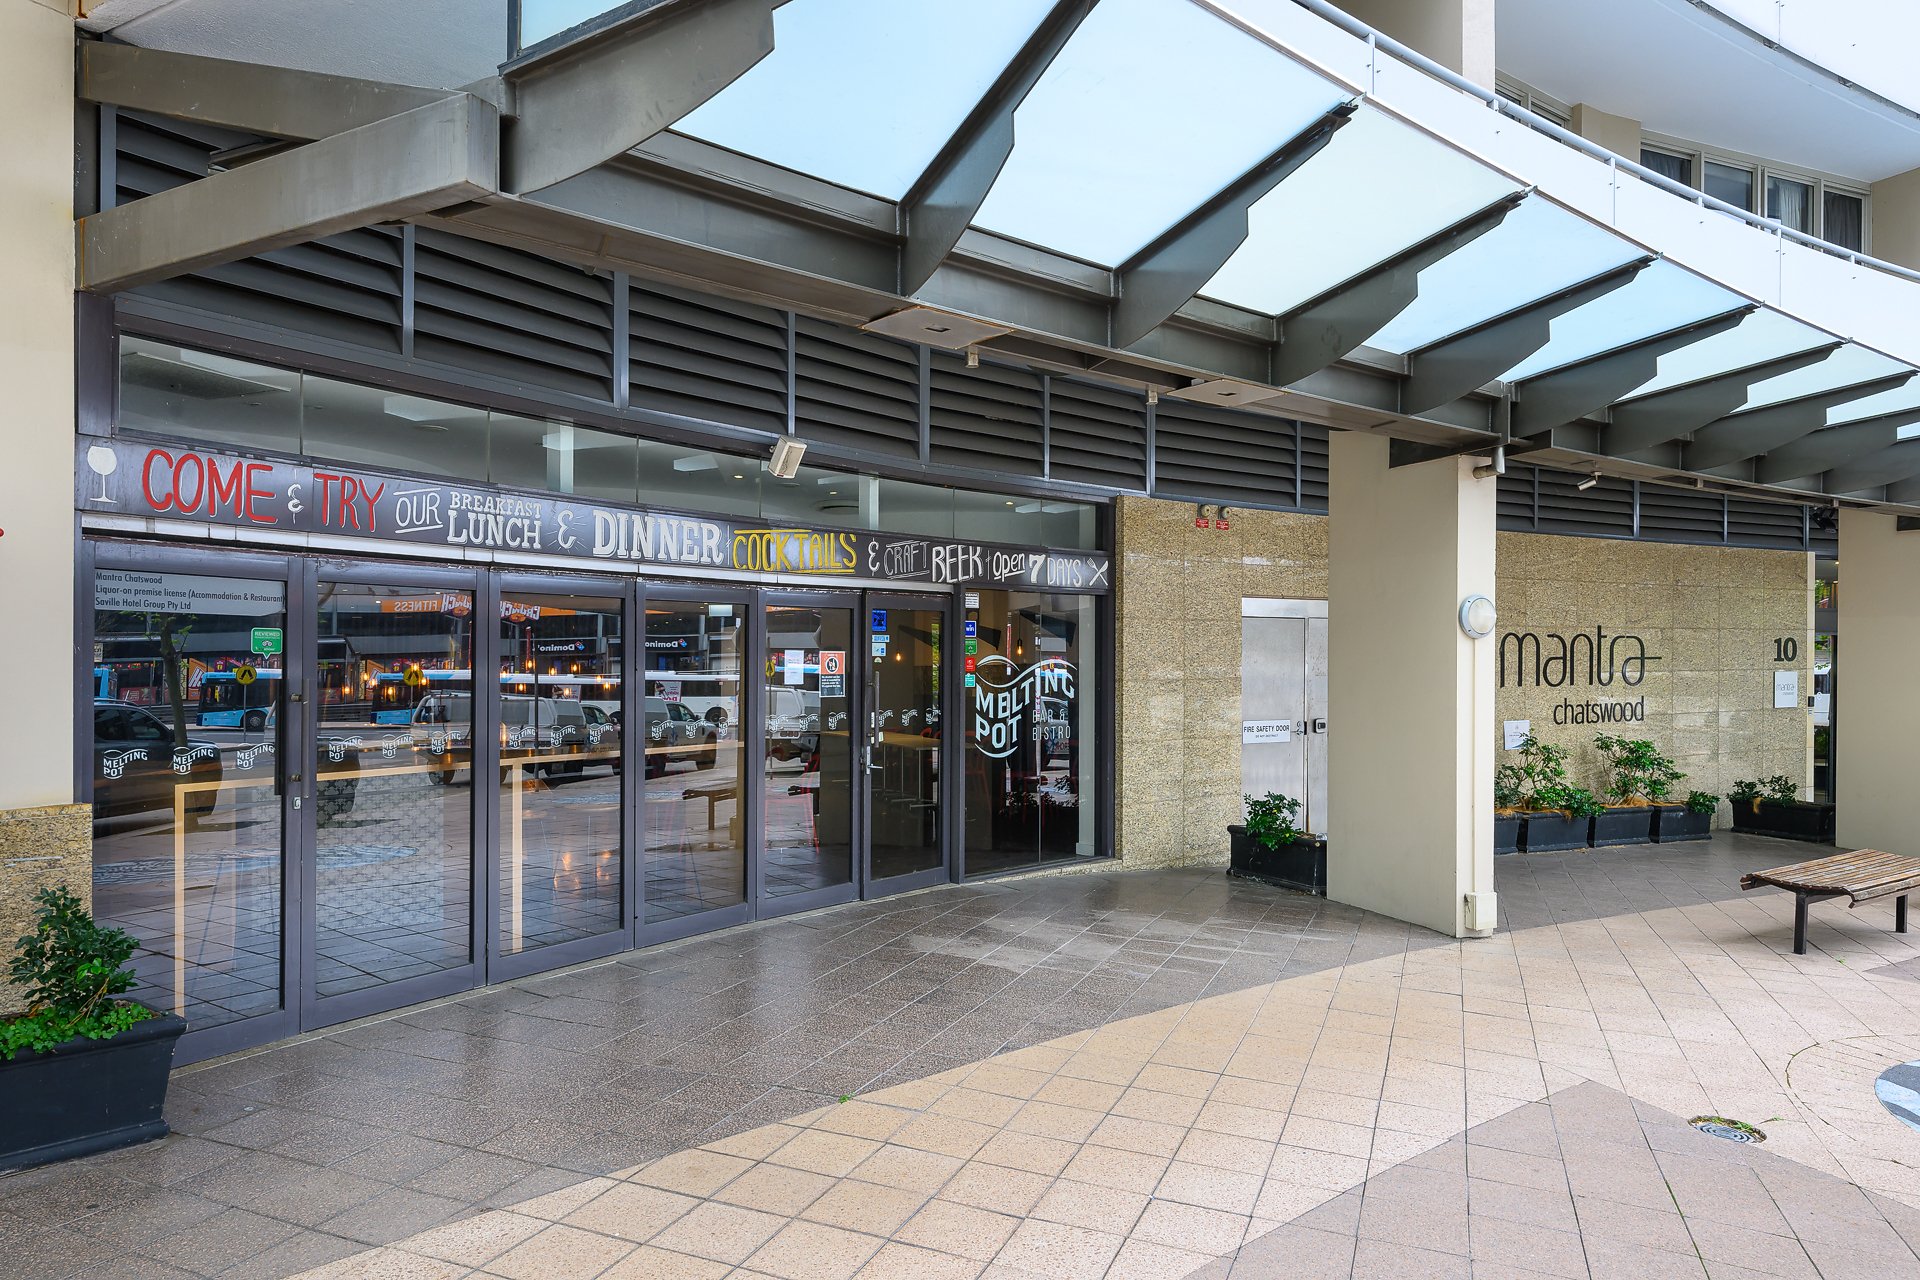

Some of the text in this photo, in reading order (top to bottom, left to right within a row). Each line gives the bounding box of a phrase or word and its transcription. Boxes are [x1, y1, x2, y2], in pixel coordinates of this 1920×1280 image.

[142, 448, 443, 532] COME & TRY OUR
[449, 491, 542, 519] BREAKFAST
[446, 510, 542, 549] LUNCH
[557, 509, 577, 549] &
[593, 508, 725, 565] DINNER
[732, 532, 858, 571] COCKTAILS
[867, 540, 880, 575] &
[883, 542, 930, 576] CRAFT
[992, 551, 1026, 582] open
[1029, 554, 1046, 584] 7
[1047, 557, 1083, 587] DAYS
[95, 571, 163, 585] Mantra Chatswood
[95, 584, 132, 595] Liquor-on
[134, 588, 163, 597] premise
[164, 588, 187, 598] license
[188, 588, 242, 601] (Accommodation
[243, 592, 249, 601] &
[95, 596, 191, 611] Saville Hotel Group Pty Ltd
[1500, 624, 1663, 688] mantra
[1773, 636, 1798, 662] 10
[975, 668, 1076, 719] MELTING
[1032, 709, 1054, 723] BAR
[1552, 695, 1645, 725] chatswood
[508, 729, 536, 741] MELTING
[550, 726, 577, 741] MELTING
[975, 712, 1023, 749] POT
[1032, 725, 1071, 741] BISTRO
[1243, 724, 1290, 733] FIRE SAFETY DOOR
[328, 738, 363, 752] MELTING
[381, 735, 415, 750] MELTING
[431, 732, 462, 746] MELTING
[508, 739, 522, 748] POT
[236, 744, 276, 761] MELTING
[328, 750, 346, 760] POT
[381, 748, 398, 757] POT
[431, 744, 446, 753] POT
[103, 751, 148, 768] MELTING
[172, 748, 215, 766] MELTING
[236, 758, 255, 768] POT
[103, 766, 125, 777] POT
[172, 763, 193, 773] POT
